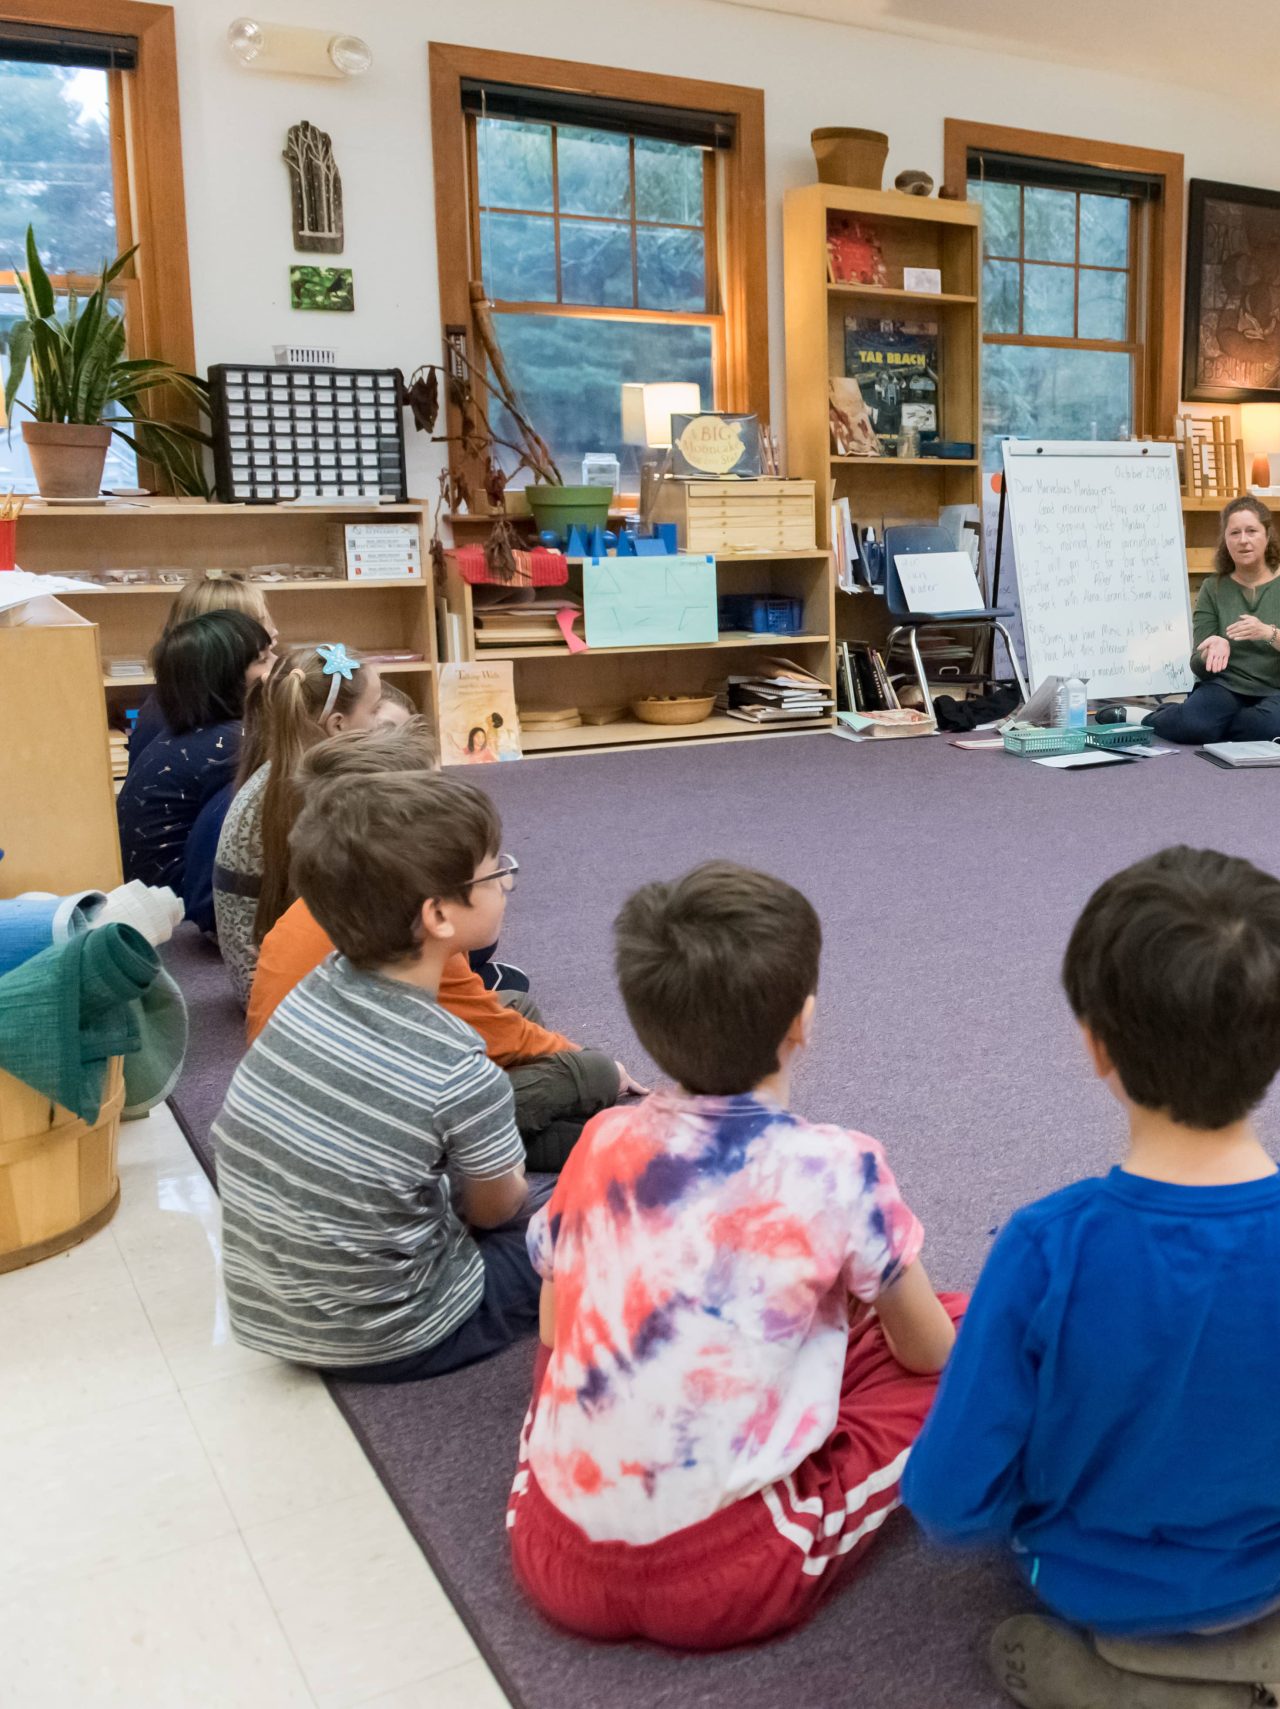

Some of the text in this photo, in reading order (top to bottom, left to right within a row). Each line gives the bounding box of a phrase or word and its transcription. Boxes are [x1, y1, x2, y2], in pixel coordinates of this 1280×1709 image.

[859, 350, 926, 367] TAR BEACH
[700, 425, 733, 441] BIG
[1114, 466, 1142, 479] October
[1014, 478, 1032, 494] Dear
[1036, 479, 1072, 496] Marvelous
[1133, 504, 1146, 513] are
[1003, 1640, 1029, 1690] DES
